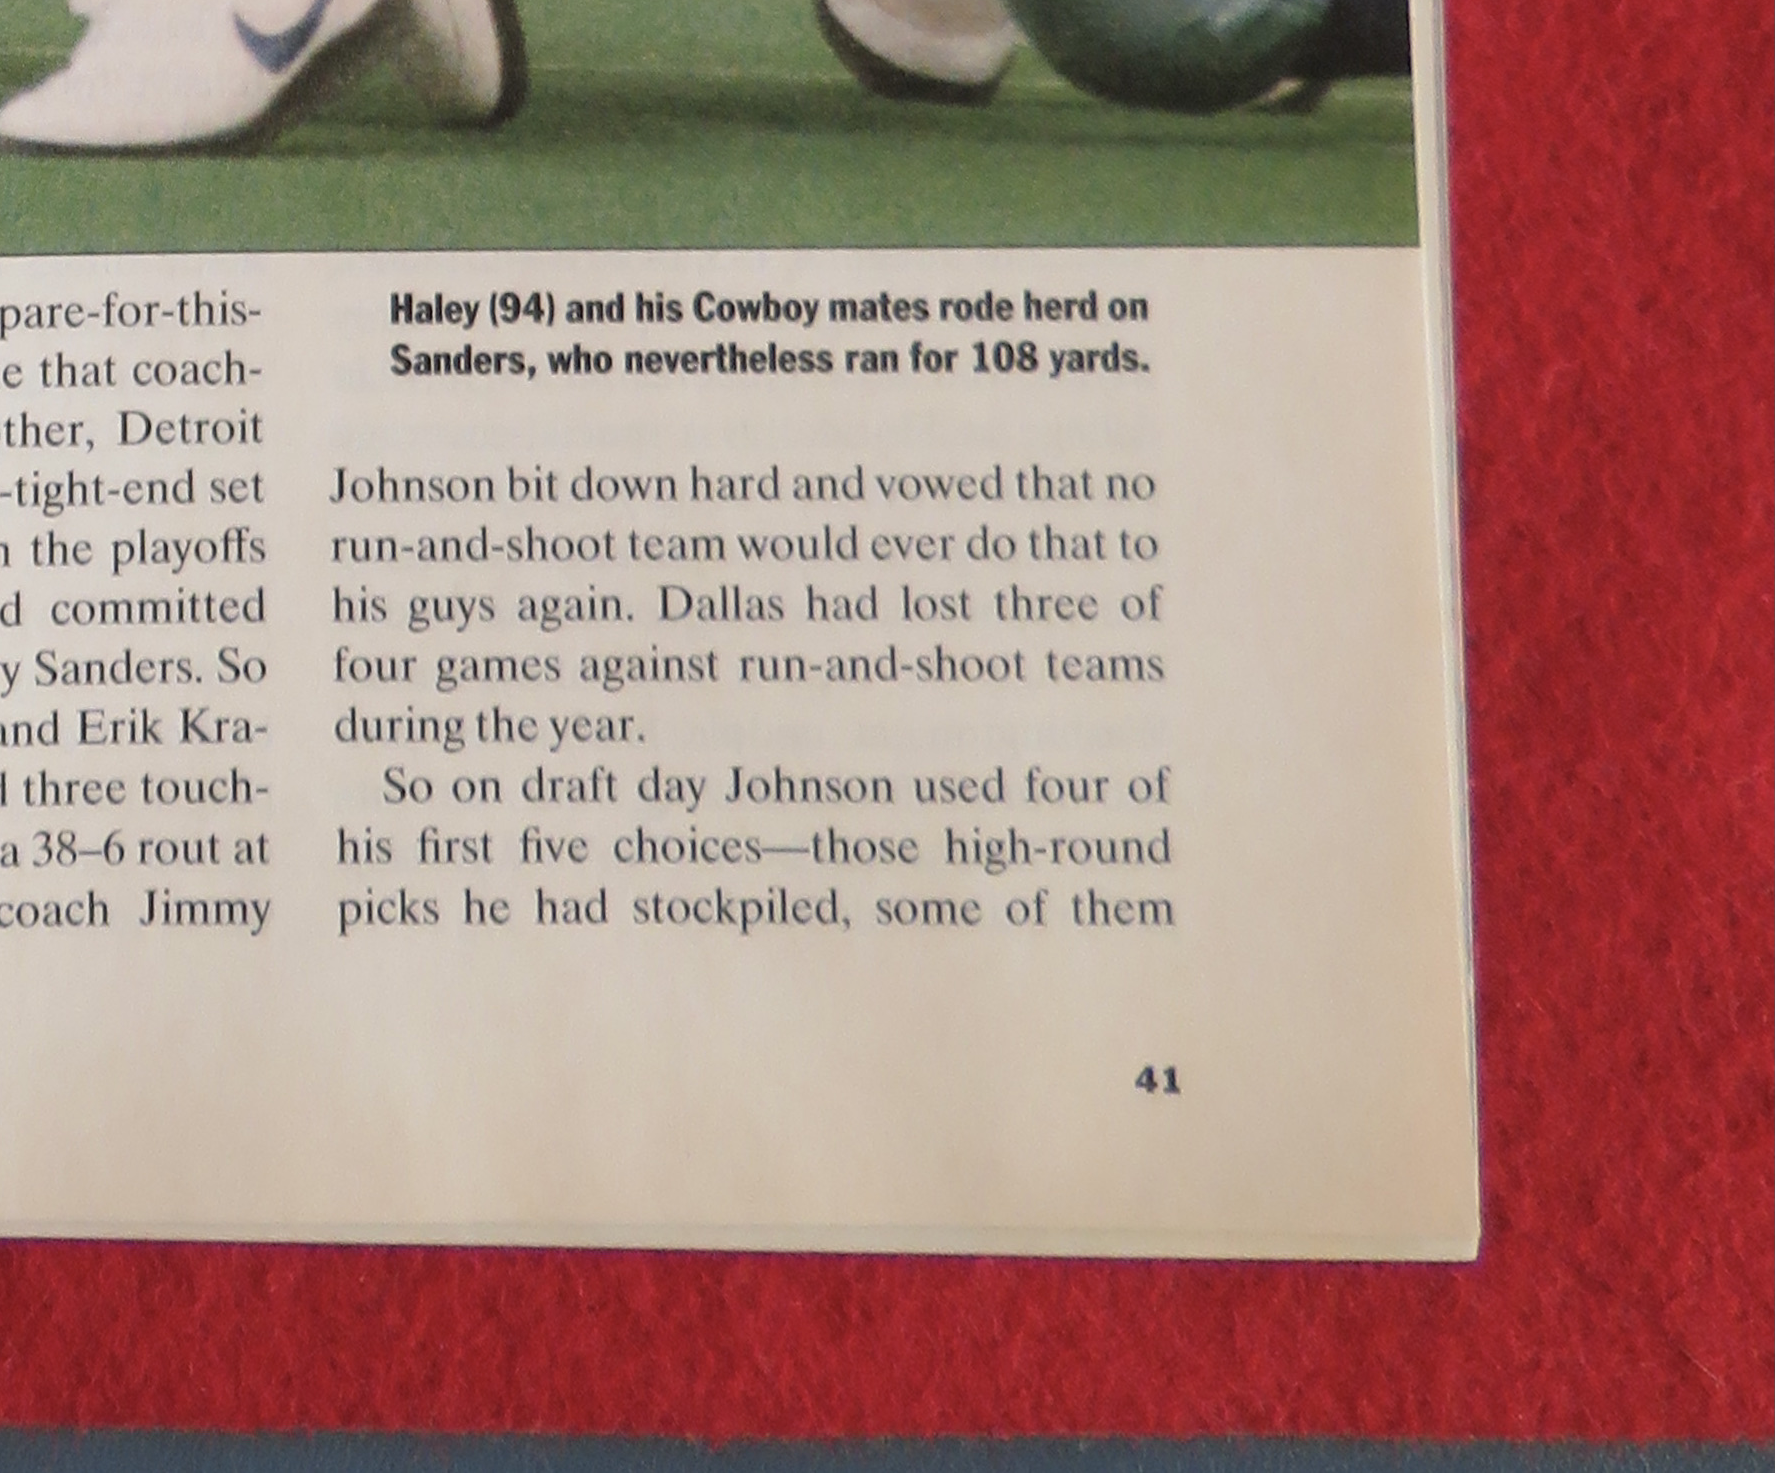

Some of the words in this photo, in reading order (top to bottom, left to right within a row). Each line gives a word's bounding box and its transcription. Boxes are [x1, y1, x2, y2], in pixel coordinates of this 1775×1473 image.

[390, 291, 481, 331] Haley
[489, 290, 556, 329] (94)
[565, 290, 625, 324] and
[635, 290, 684, 324] his
[692, 289, 820, 330] Cowboy
[829, 291, 931, 323] mates
[939, 289, 1015, 324] rode
[1024, 288, 1099, 322] herd
[1108, 297, 1149, 323] on
[39, 351, 117, 388] that
[133, 348, 262, 387] coach-
[390, 343, 538, 381] Sanders,
[546, 342, 613, 375] who
[624, 341, 834, 376] nevertheless
[845, 349, 899, 374] ran
[908, 339, 959, 374] for
[971, 339, 1040, 374] 108
[1049, 340, 1150, 380] yards.
[210, 472, 264, 504] set
[329, 466, 497, 504] Johnson
[507, 464, 558, 502] bit
[570, 465, 678, 503] down
[690, 464, 781, 502] hard
[793, 464, 865, 502] and
[875, 464, 1004, 501] vowed
[1016, 463, 1094, 501] that
[1106, 473, 1156, 501] no
[51, 585, 266, 626] committed
[333, 585, 387, 623] his
[408, 596, 495, 634] guys
[518, 584, 633, 633] again.
[657, 584, 785, 623] Dallas
[806, 584, 878, 622] had
[901, 583, 972, 622] lost
[994, 583, 1098, 622] three
[1120, 584, 1164, 622] of
[77, 706, 163, 745] Erik
[179, 706, 268, 744] Kra-
[335, 705, 465, 754] during
[476, 705, 539, 743] the
[549, 715, 645, 753] year.
[139, 887, 271, 937] Jimmy
[338, 887, 440, 937] picks
[464, 886, 510, 926] he
[535, 886, 608, 925] had
[633, 886, 851, 936] stockpiled,
[876, 898, 982, 927] some
[1006, 888, 1049, 927] of
[1072, 887, 1176, 927] them
[1135, 1065, 1181, 1095] 41
